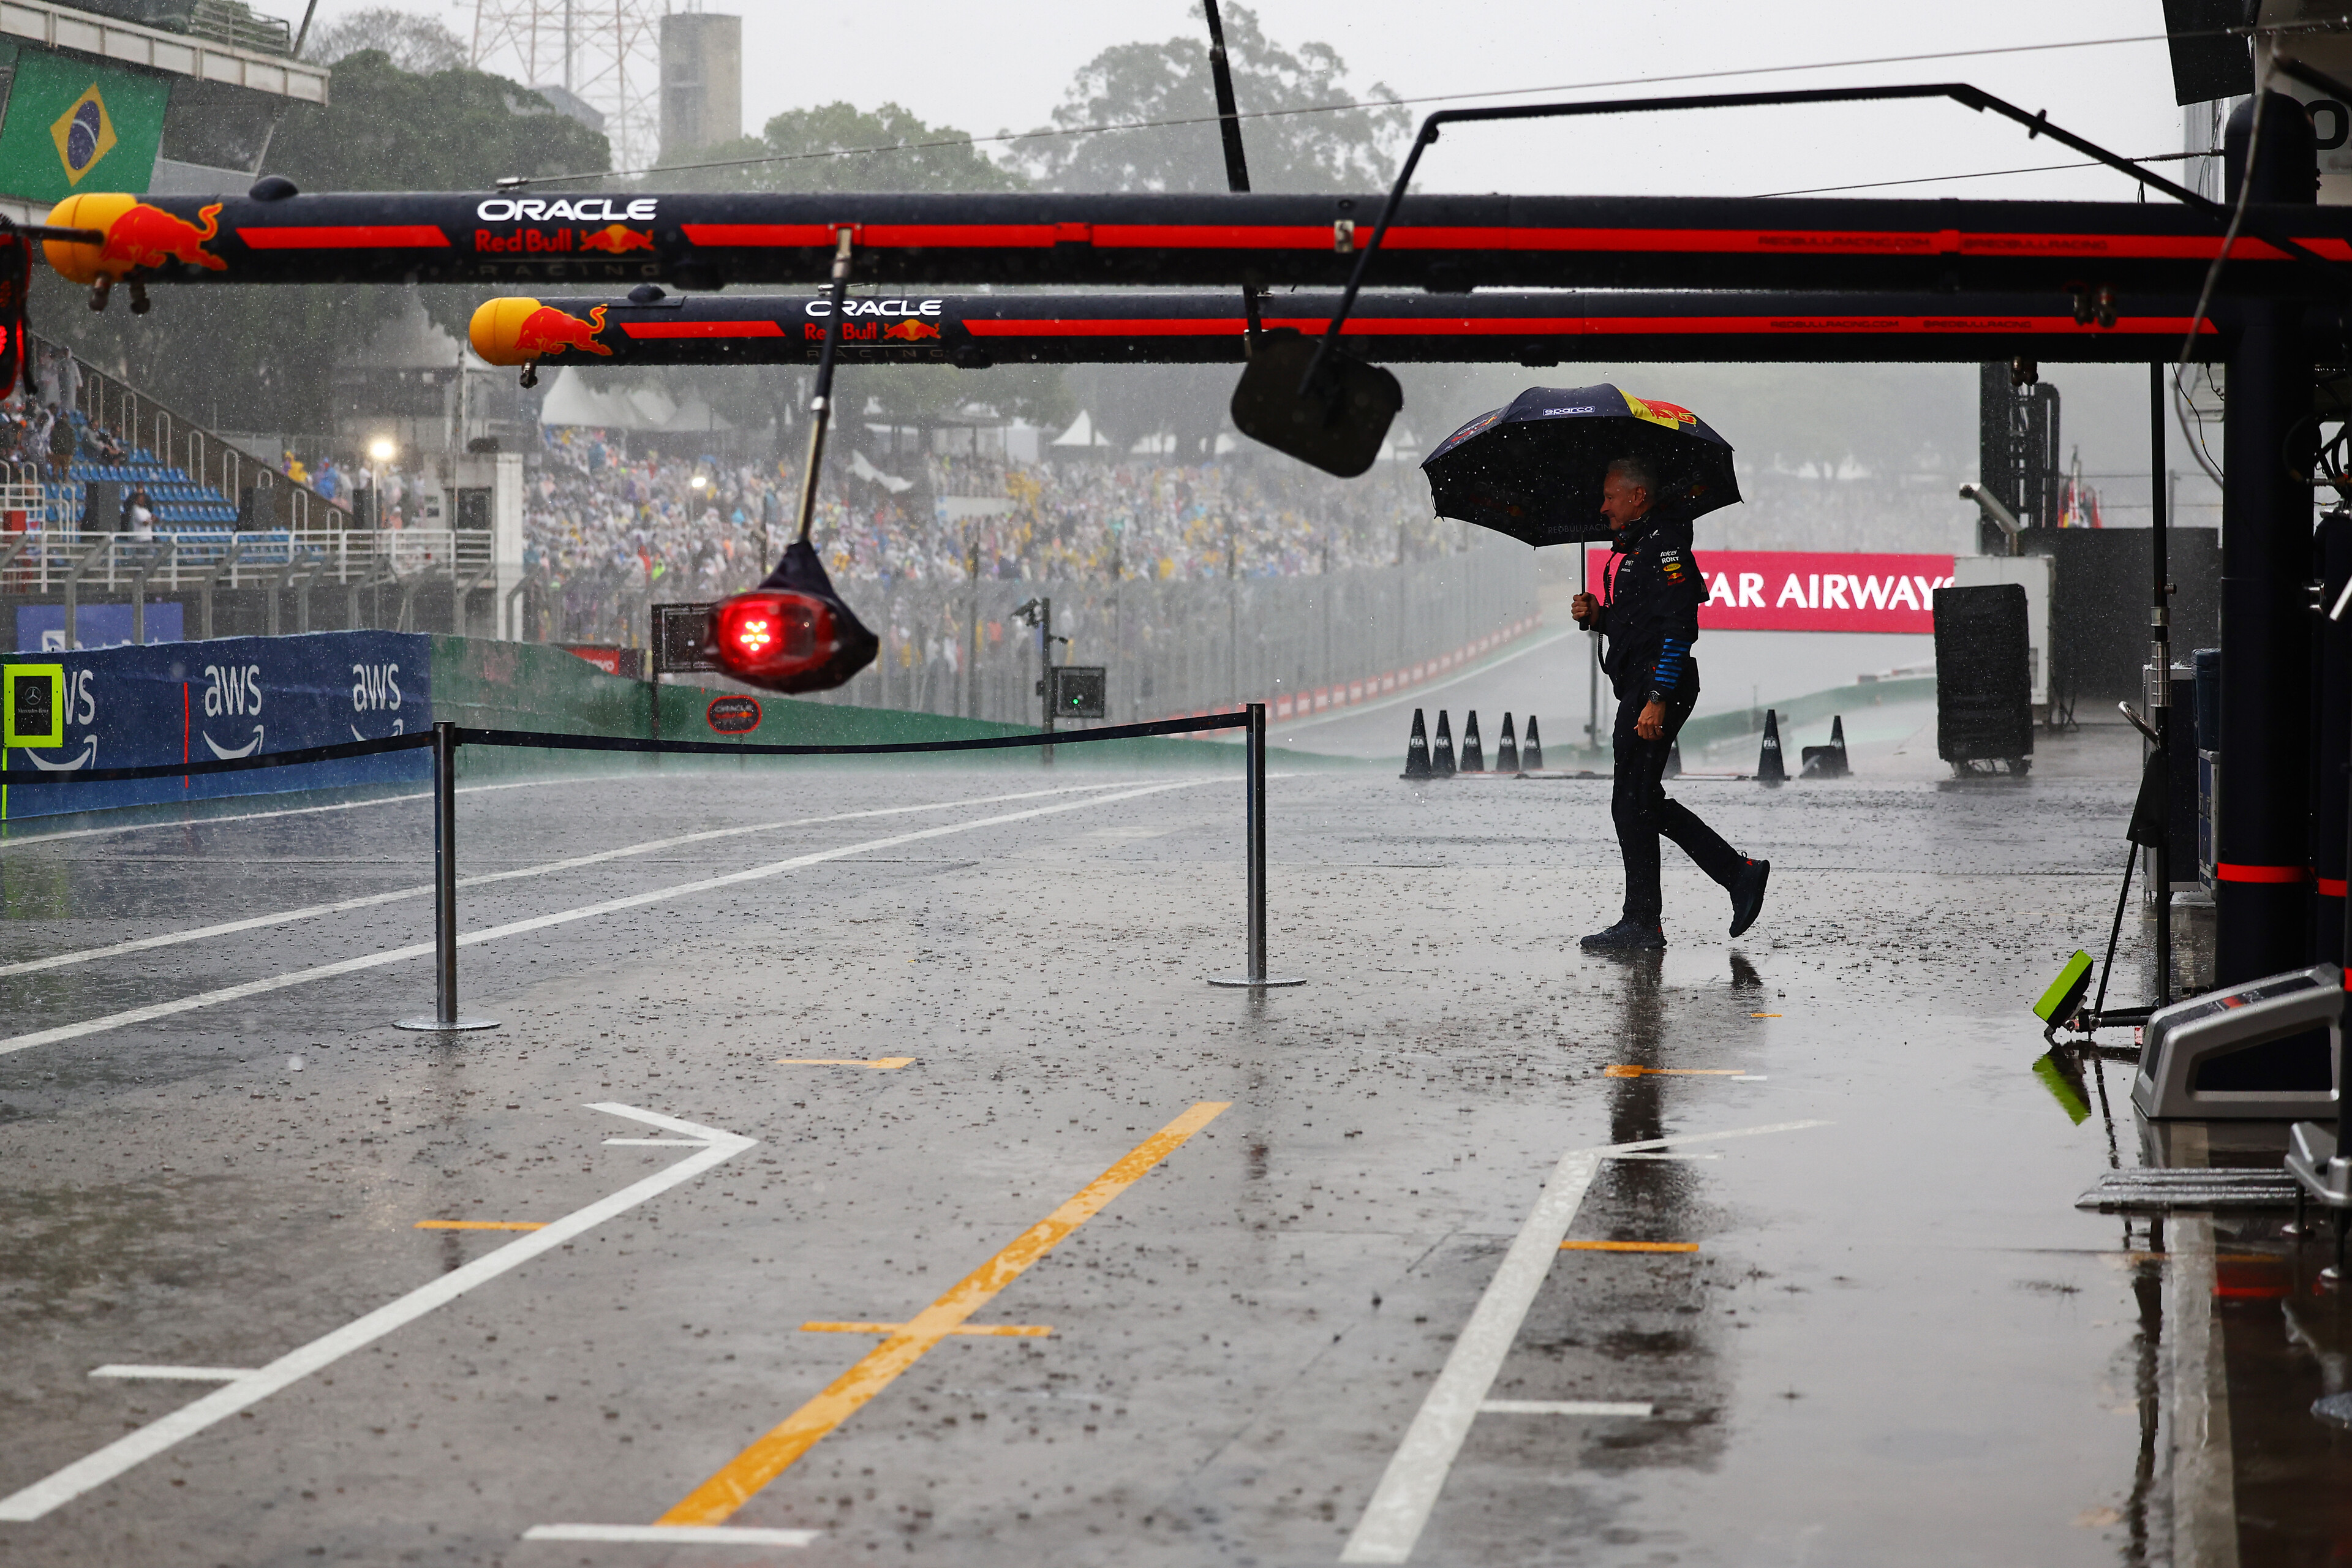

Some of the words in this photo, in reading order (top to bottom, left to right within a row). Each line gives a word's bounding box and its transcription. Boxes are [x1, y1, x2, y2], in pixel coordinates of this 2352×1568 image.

[477, 198, 660, 221] ORACLE
[475, 228, 522, 252] Red
[526, 227, 572, 252] Bull
[804, 323, 826, 340] Re
[842, 322, 877, 340] Bull
[807, 350, 943, 358] RACING
[205, 665, 263, 717] aws
[352, 663, 402, 712] aws
